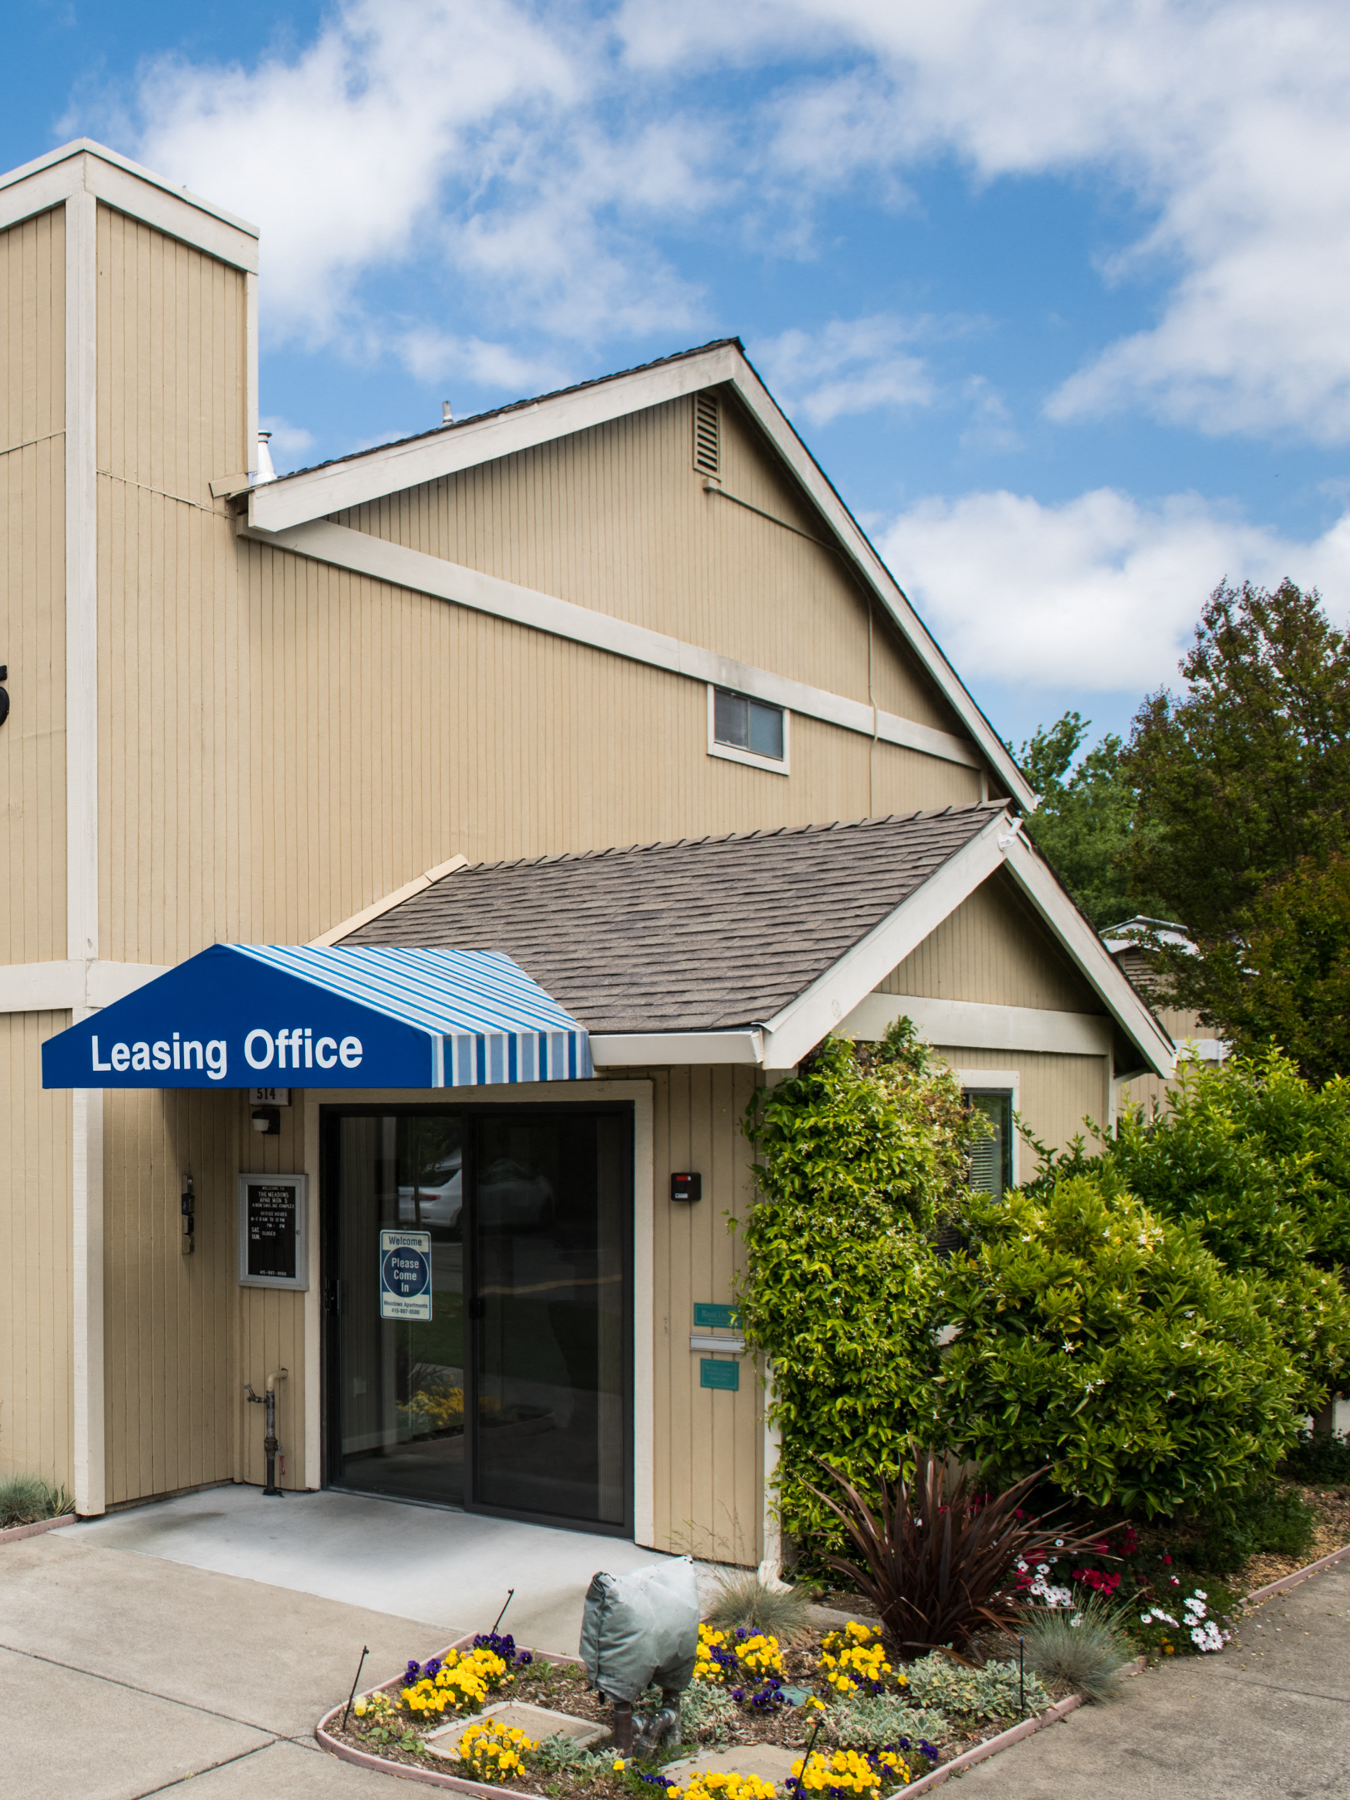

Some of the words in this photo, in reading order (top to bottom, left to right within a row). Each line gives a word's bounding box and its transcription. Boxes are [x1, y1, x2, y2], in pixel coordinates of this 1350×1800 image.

[91, 1031, 228, 1080] Leasing
[243, 1027, 363, 1070] Office
[256, 1088, 276, 1100] 514
[388, 1235, 423, 1247] Welcome
[391, 1257, 420, 1269] Please
[393, 1269, 417, 1281] Come
[401, 1282, 409, 1293] In
